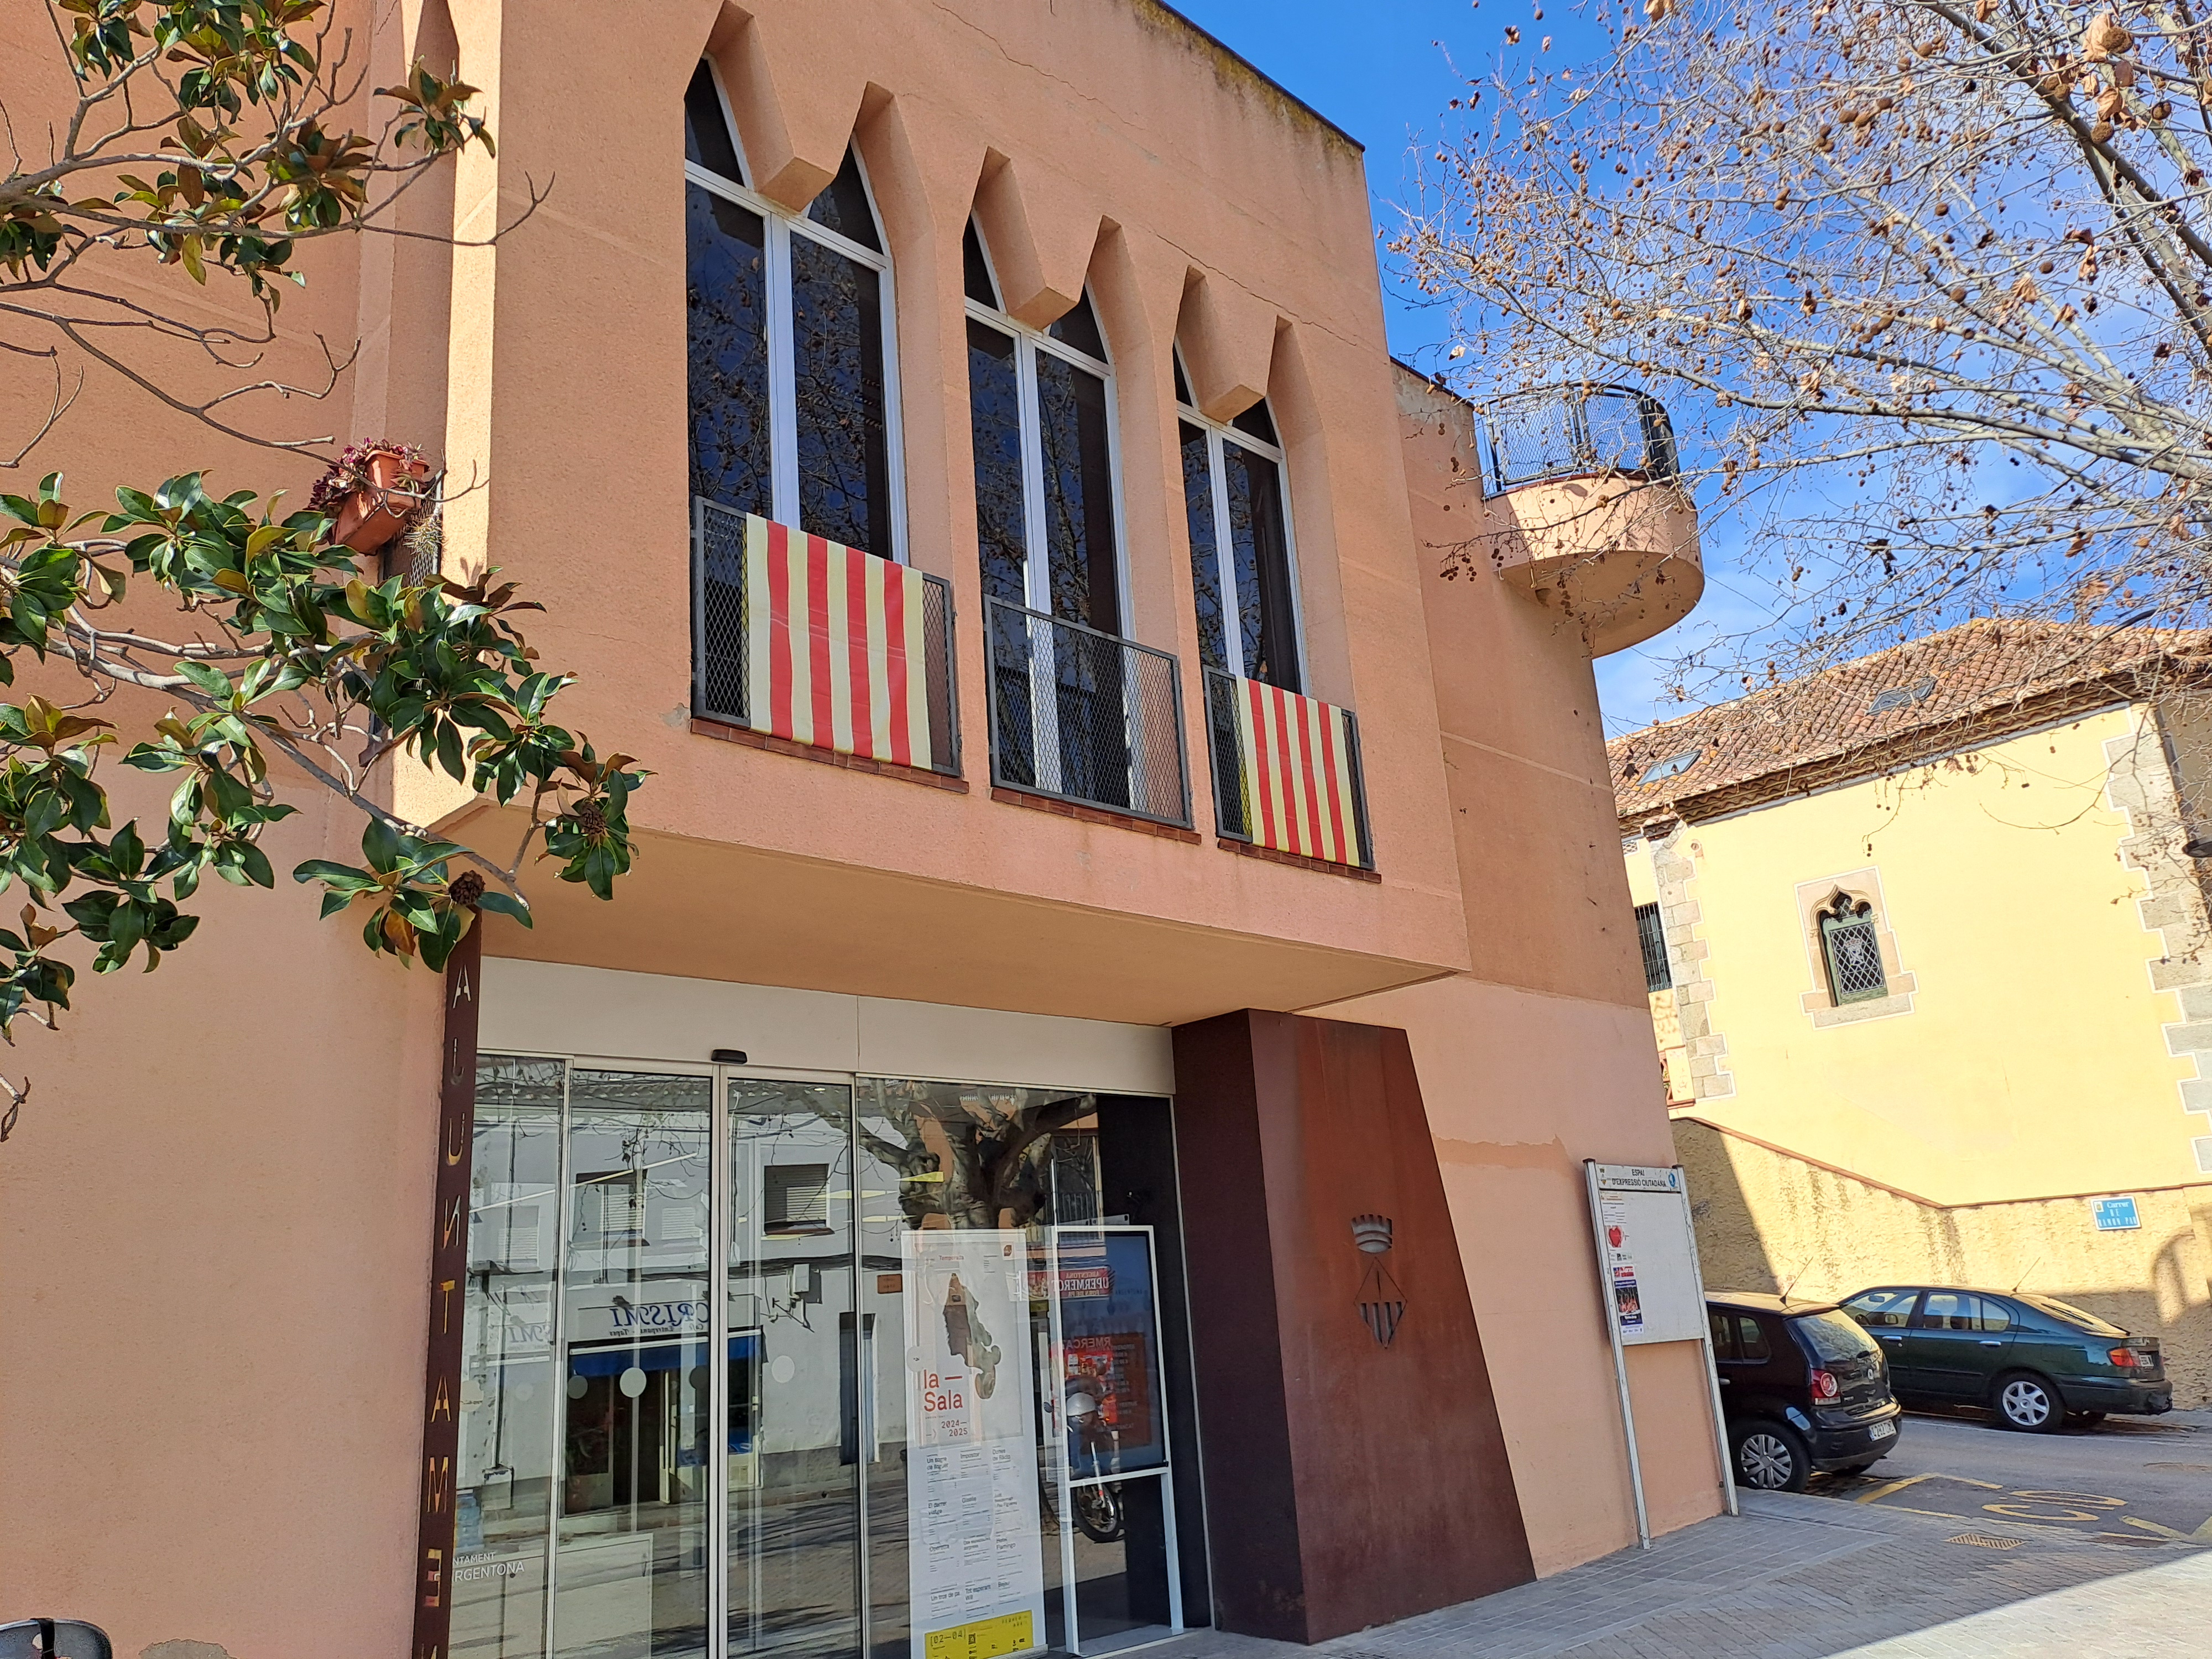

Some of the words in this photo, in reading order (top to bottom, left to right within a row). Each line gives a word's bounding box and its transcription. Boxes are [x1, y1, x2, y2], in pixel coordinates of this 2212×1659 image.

[1642, 1179, 1667, 1187] CIUTADANA
[924, 1369, 940, 1389] la
[924, 1389, 963, 1412] Sala
[948, 1427, 968, 1437] 2025
[453, 1551, 497, 1566] NTAMENT
[451, 1561, 525, 1583] RGENTONA
